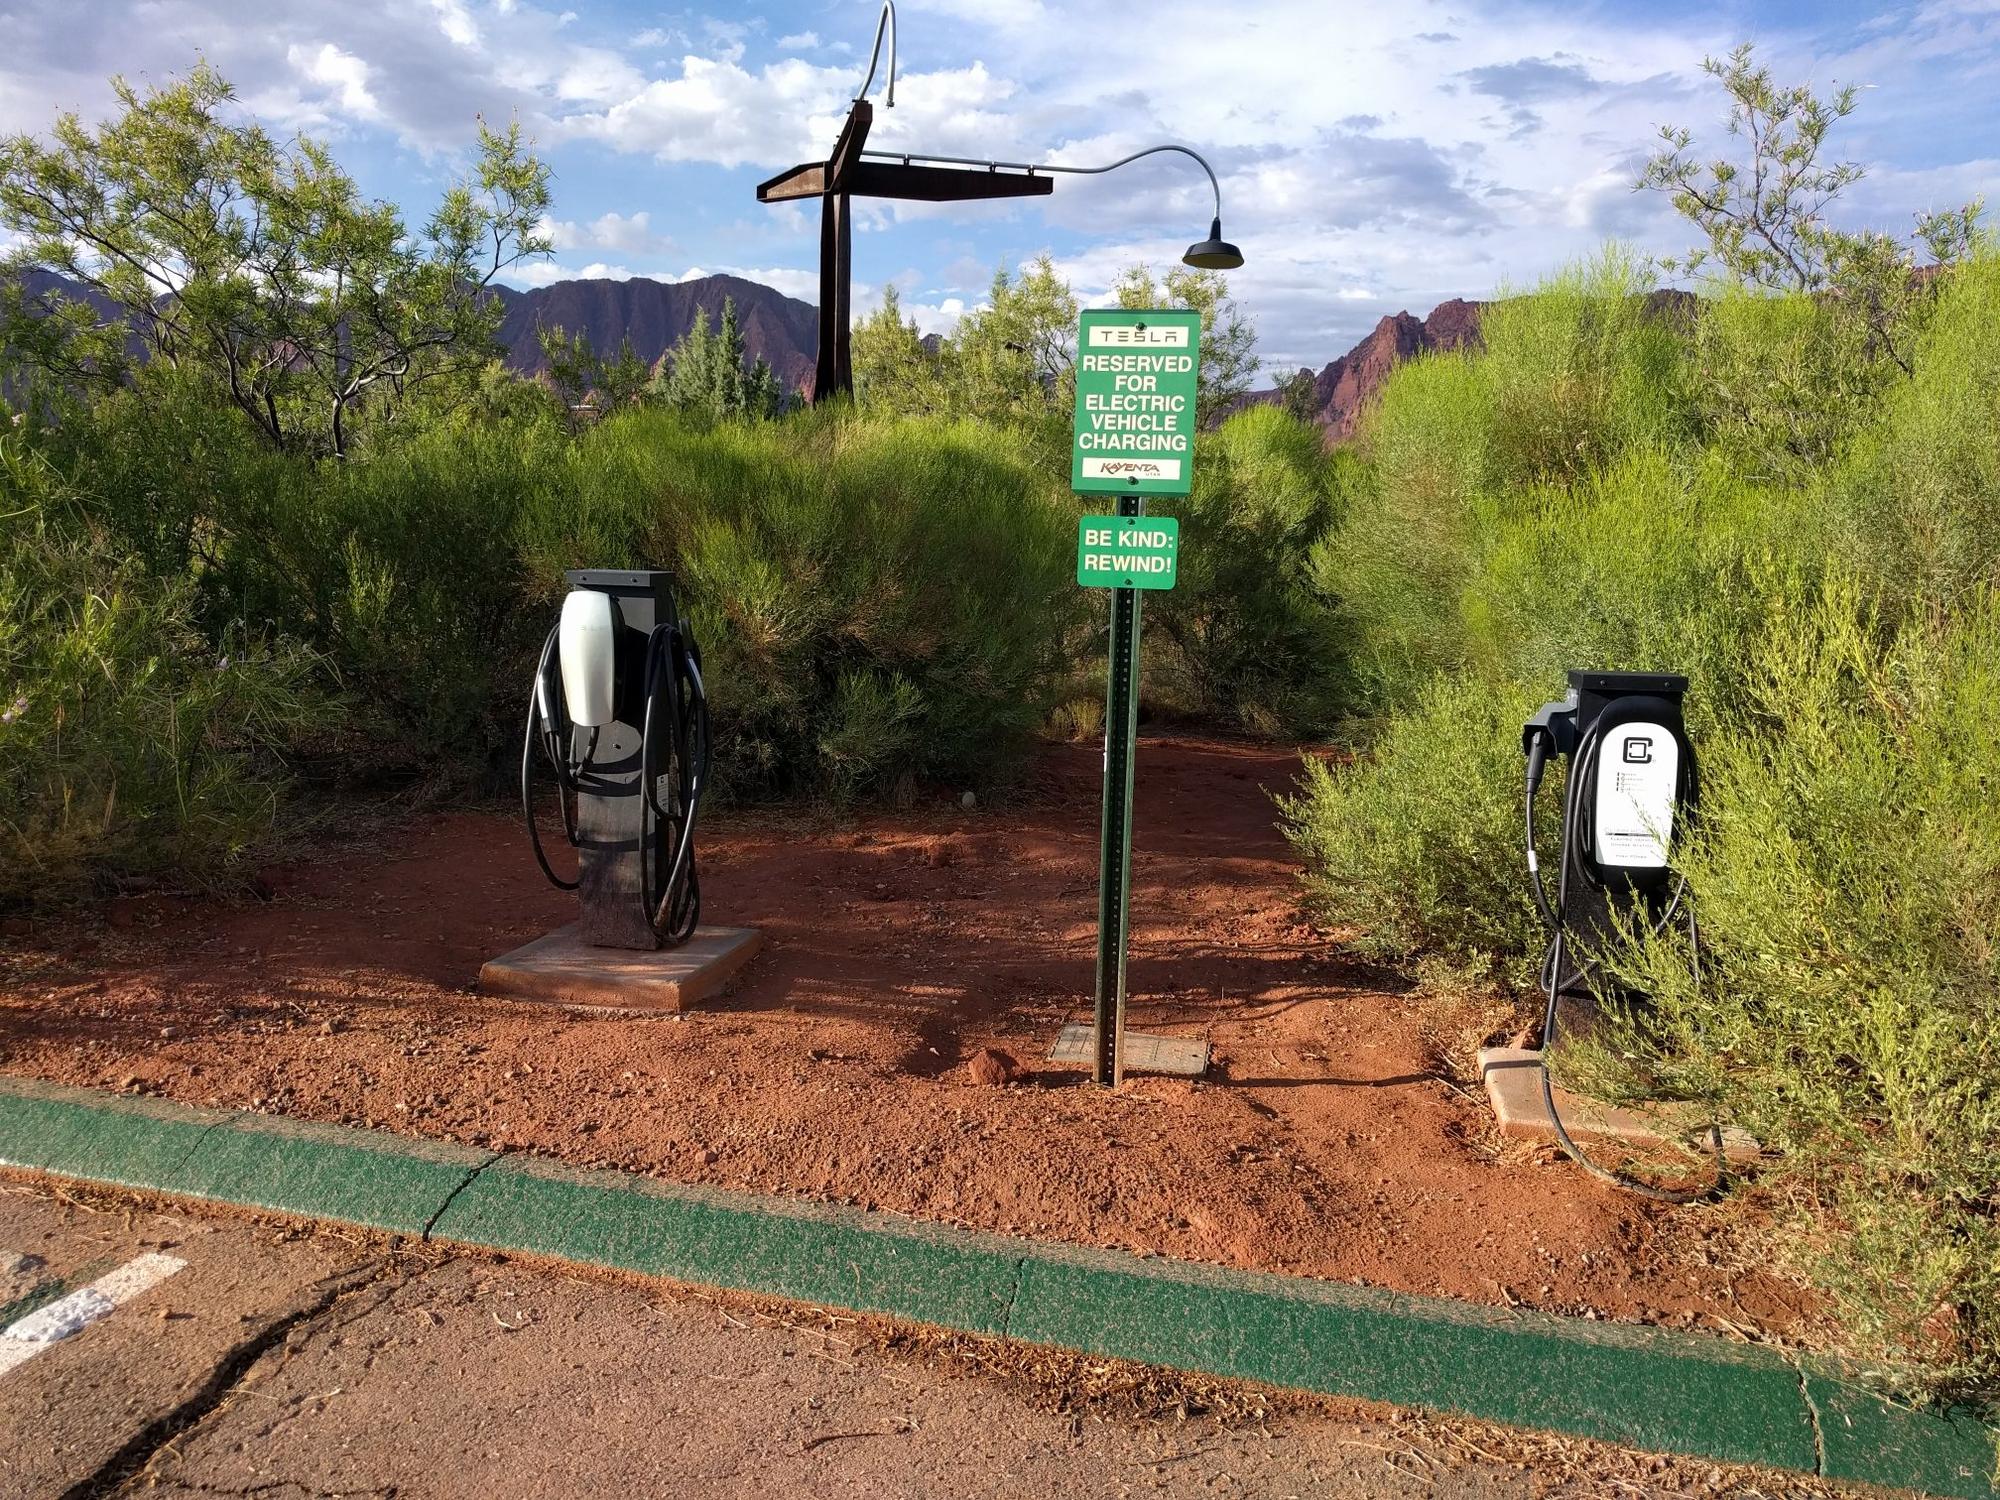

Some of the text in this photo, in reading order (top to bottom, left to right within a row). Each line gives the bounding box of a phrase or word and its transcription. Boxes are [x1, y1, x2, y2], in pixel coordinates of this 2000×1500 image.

[1101, 331, 1177, 342] TESLA
[1083, 355, 1192, 372] RESERVED
[1115, 375, 1156, 392] FOR
[1085, 394, 1185, 412] ELECTRIC
[1091, 414, 1177, 431] VEHICLE
[1078, 433, 1187, 451] CHARGING
[1100, 462, 1160, 474] KAYENTA
[1085, 529, 1173, 548] BE KIND:
[1084, 554, 1171, 573] REWIND!
